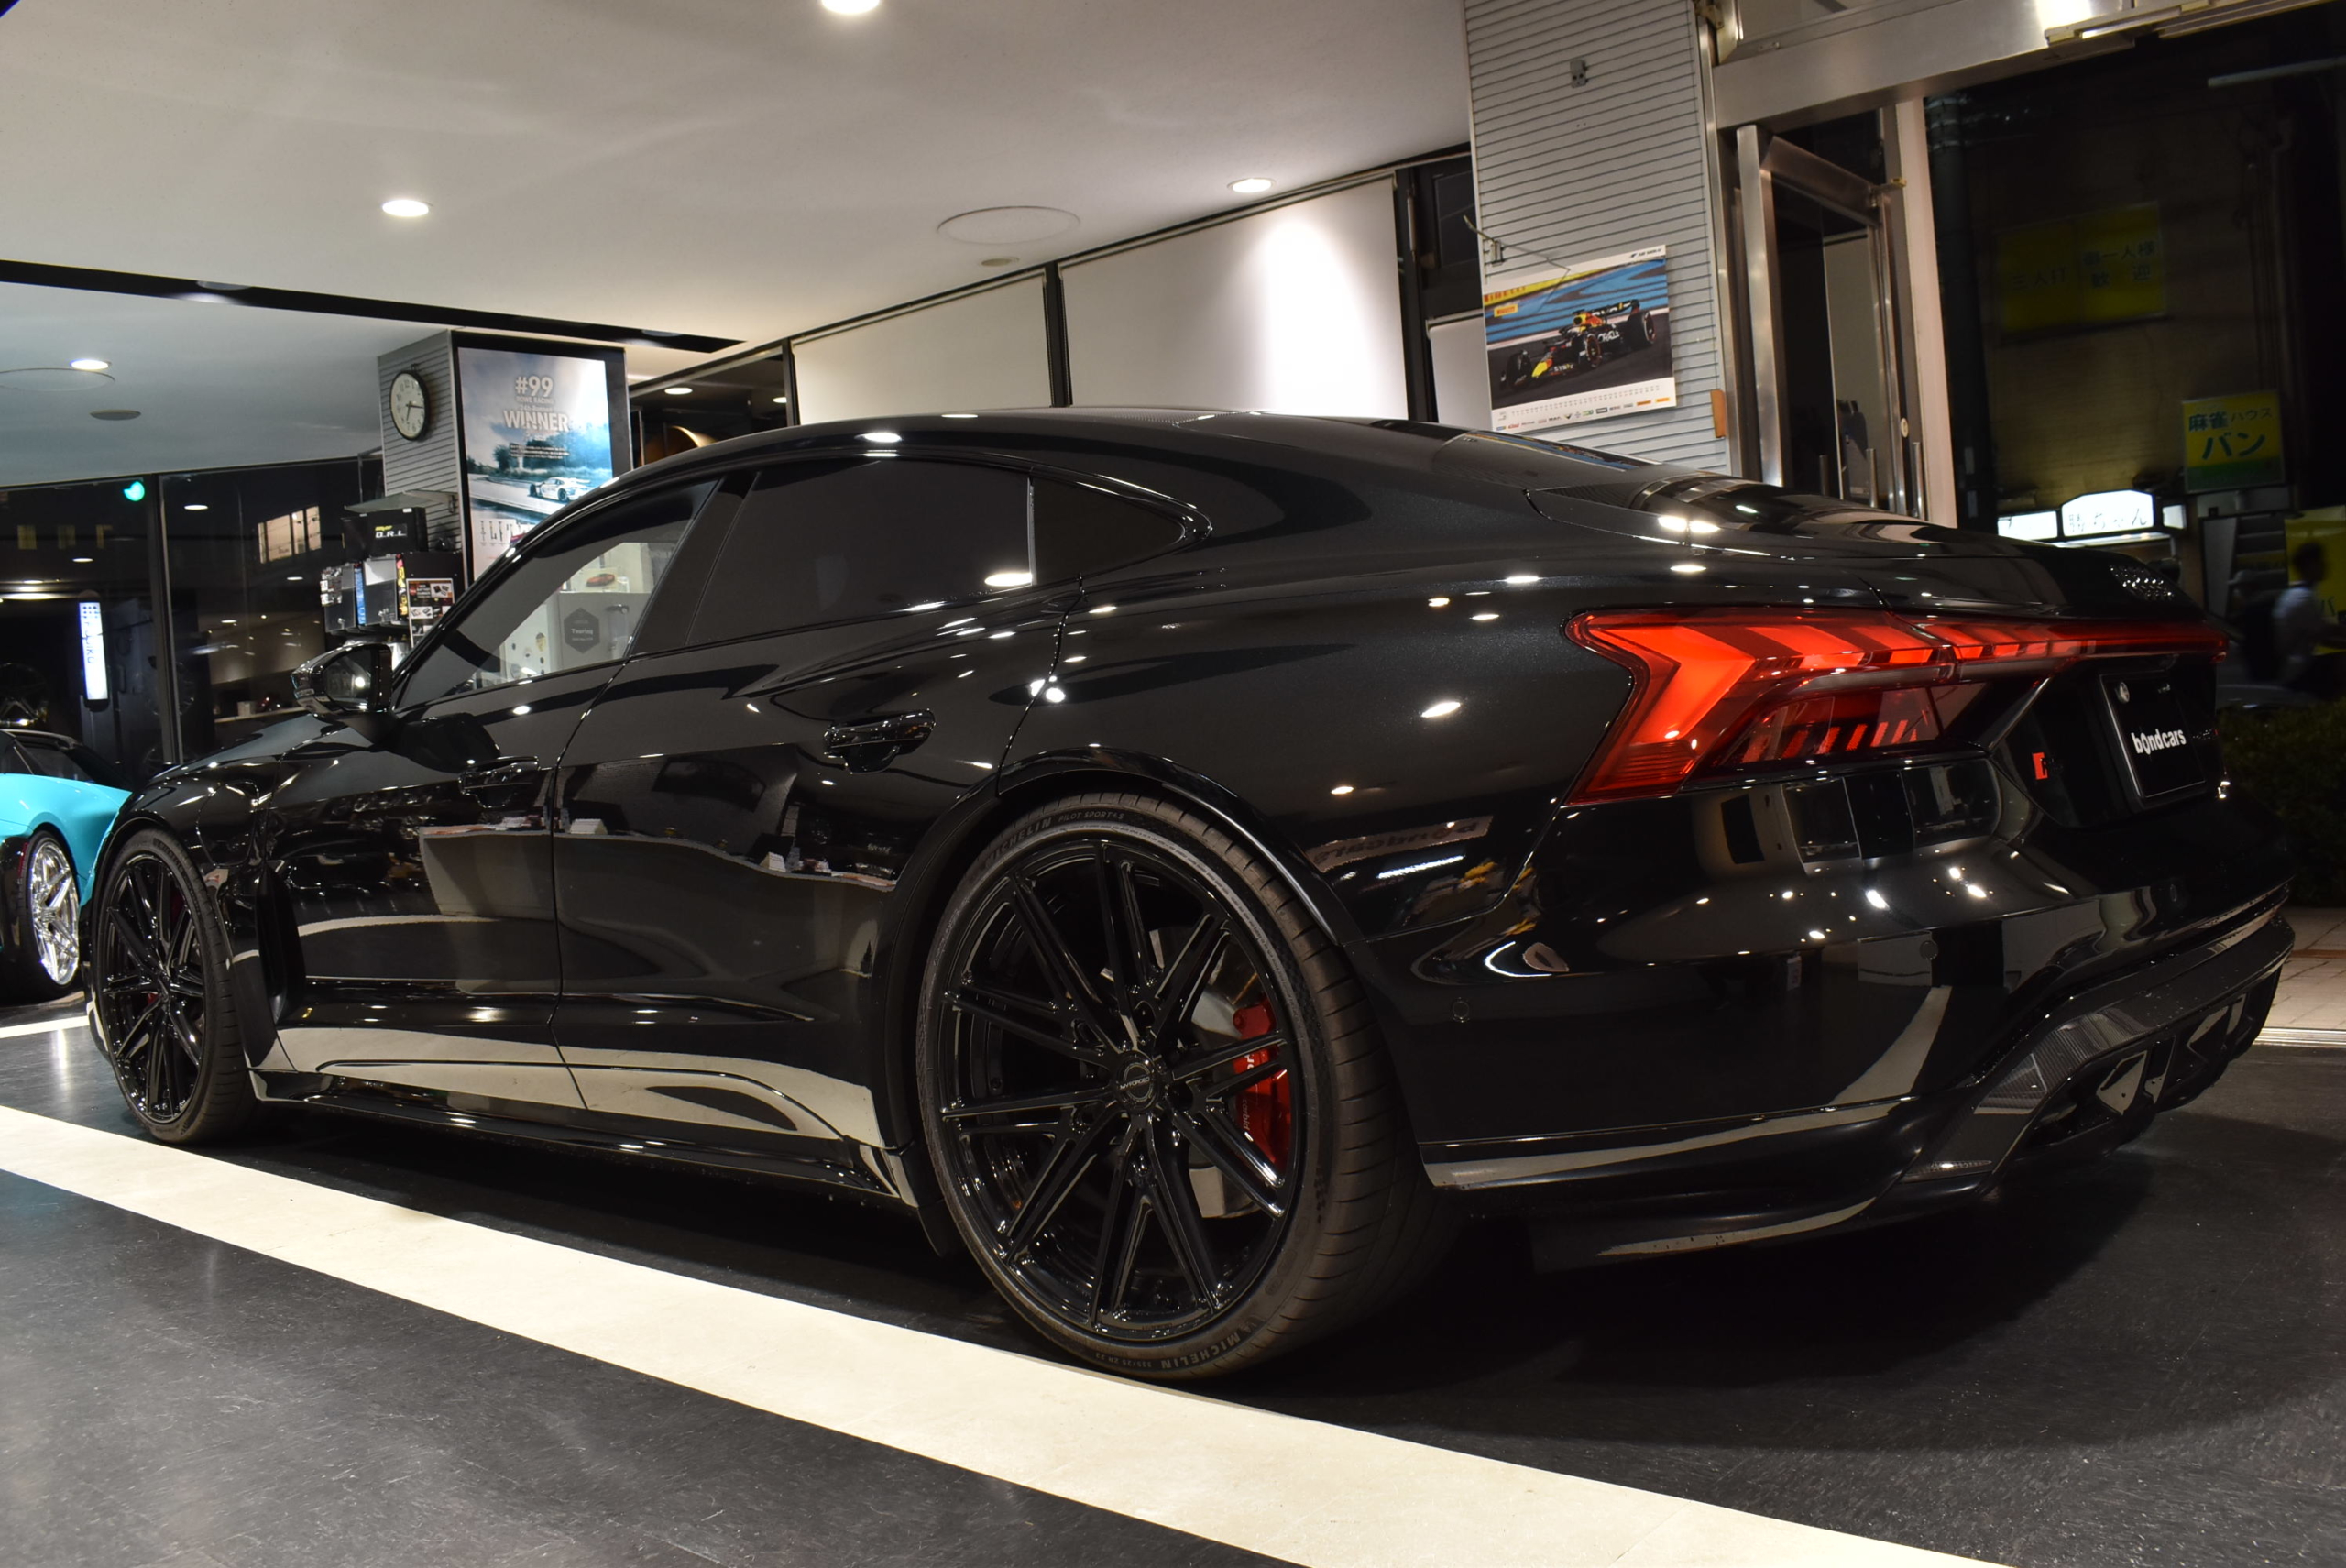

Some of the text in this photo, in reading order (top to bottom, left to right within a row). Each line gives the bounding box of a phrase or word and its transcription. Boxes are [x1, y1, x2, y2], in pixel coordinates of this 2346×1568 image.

[515, 376, 554, 397] #99
[503, 410, 569, 433] WINNER
[1058, 811, 1082, 823] PILOT
[1083, 810, 1113, 819] SPORT
[1161, 1332, 1241, 1370] MICHELIN
